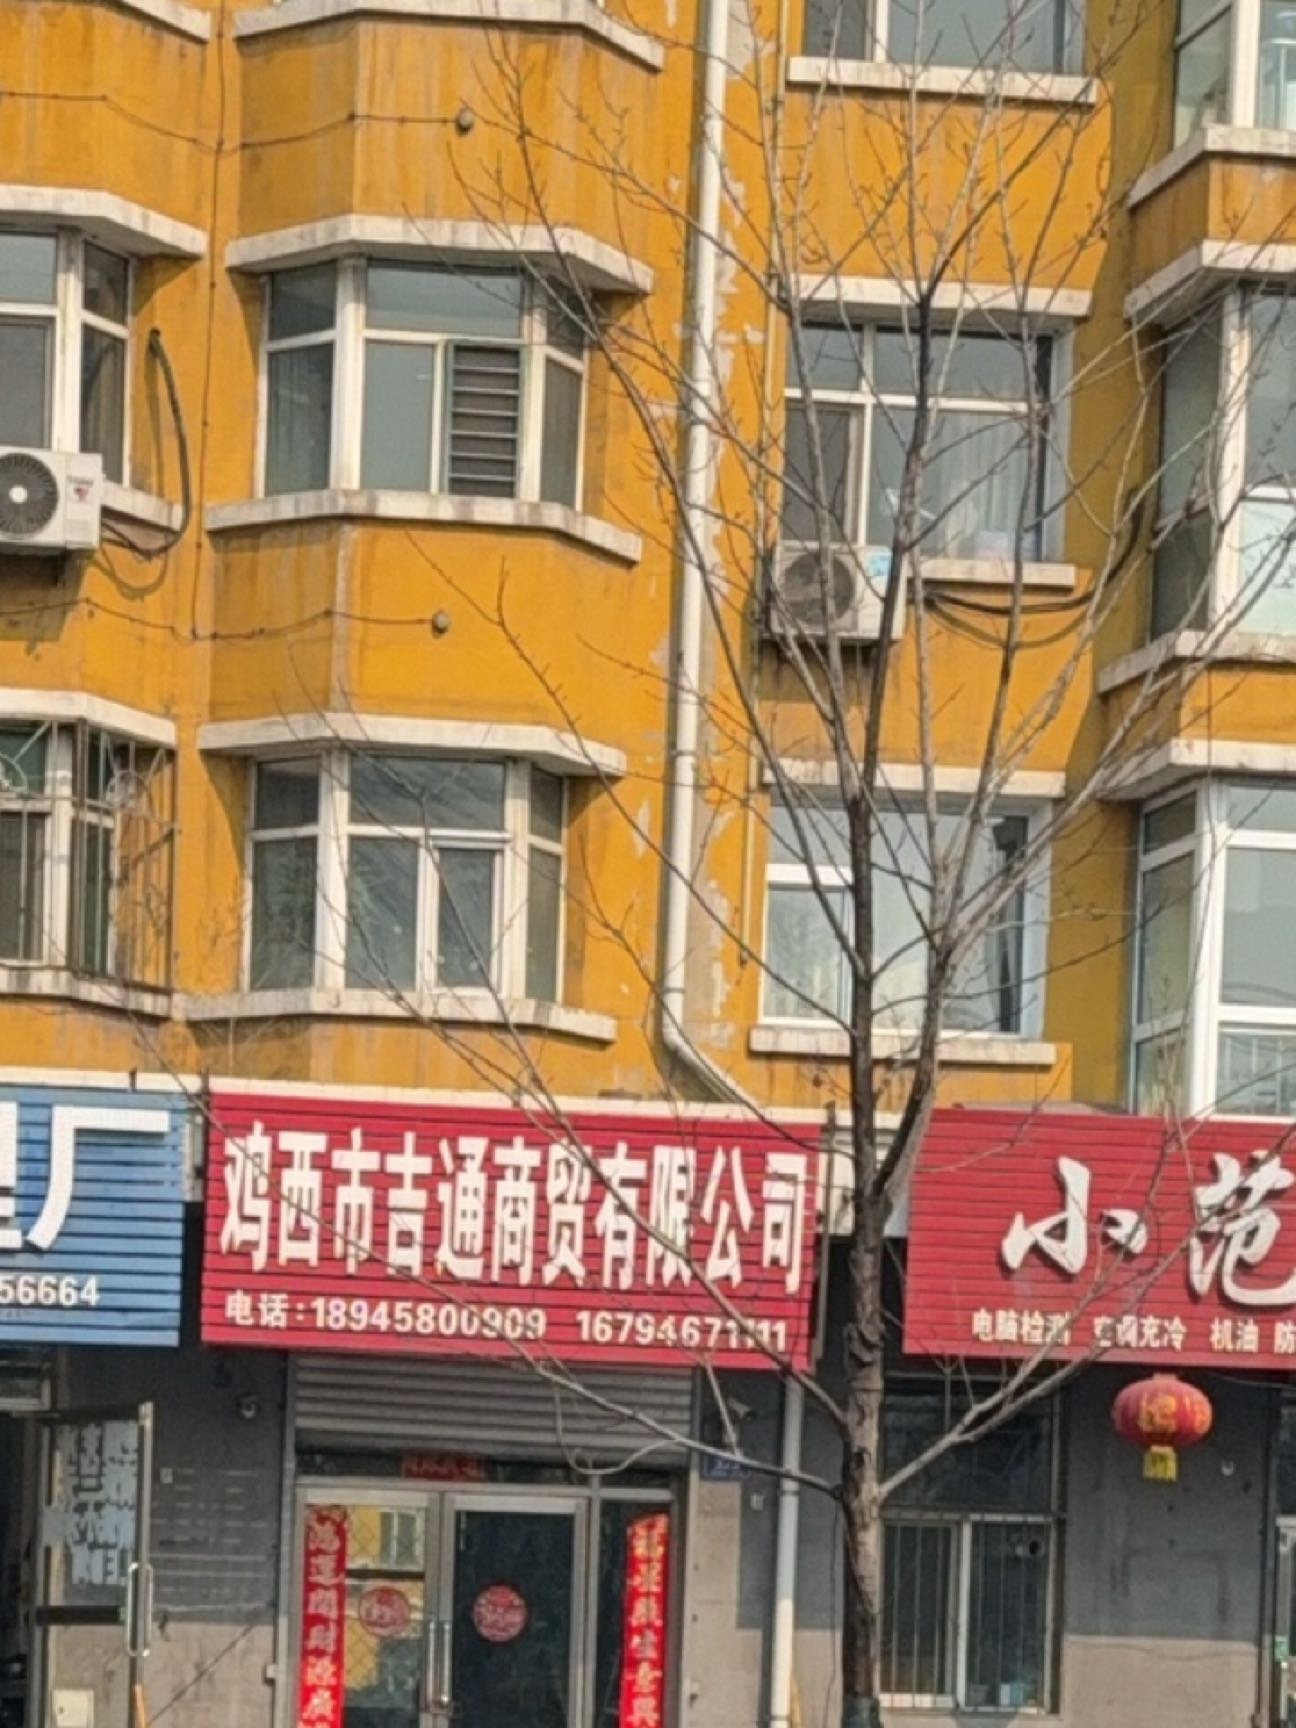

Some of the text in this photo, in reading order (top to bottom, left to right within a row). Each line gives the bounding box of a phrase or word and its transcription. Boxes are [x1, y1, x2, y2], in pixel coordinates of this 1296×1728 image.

[219, 1119, 807, 1295] 鸡西市吉通商贸有限公司
[1001, 1150, 1296, 1307] 小范
[1209, 1316, 1259, 1354] 机油
